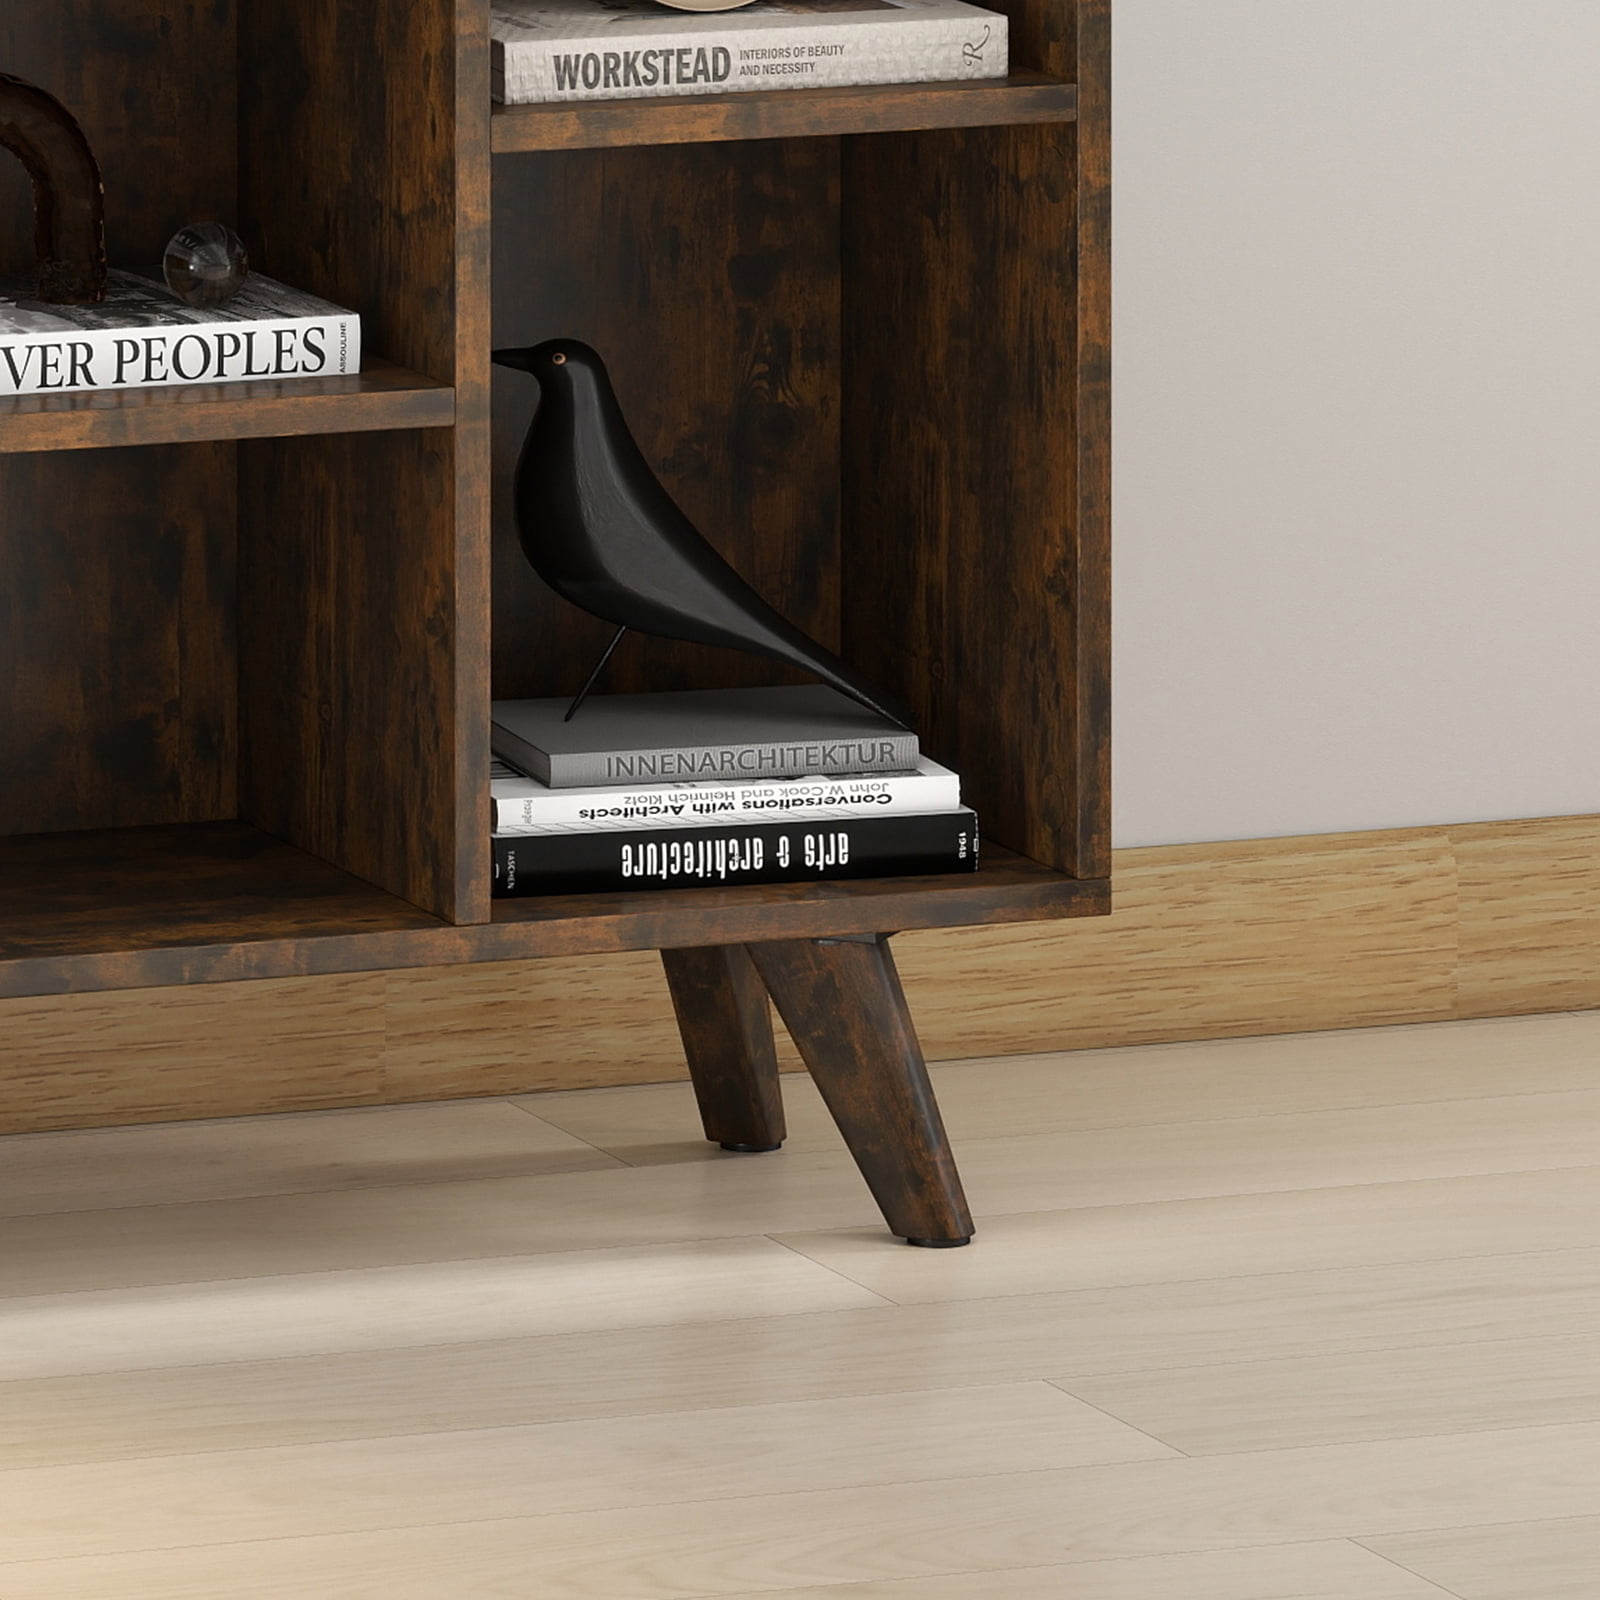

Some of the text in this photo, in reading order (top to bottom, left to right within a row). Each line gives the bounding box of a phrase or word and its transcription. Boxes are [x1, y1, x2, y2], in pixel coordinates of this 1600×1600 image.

[740, 44, 845, 60] INTERIORS OF BEAUTY
[553, 47, 731, 91] WORKSTEAD
[740, 62, 816, 76] AND NECESSITY
[111, 326, 327, 384] PEOPLES
[606, 742, 895, 777] INNENARCHITEKTUR
[624, 795, 662, 805] Klotz
[668, 791, 735, 802] Heinrich
[741, 789, 774, 799] and
[850, 783, 890, 794] John
[579, 794, 892, 819] Conversations with Architects
[621, 837, 764, 880] architecture
[804, 832, 849, 871] arts
[507, 850, 515, 889] TASCHEN
